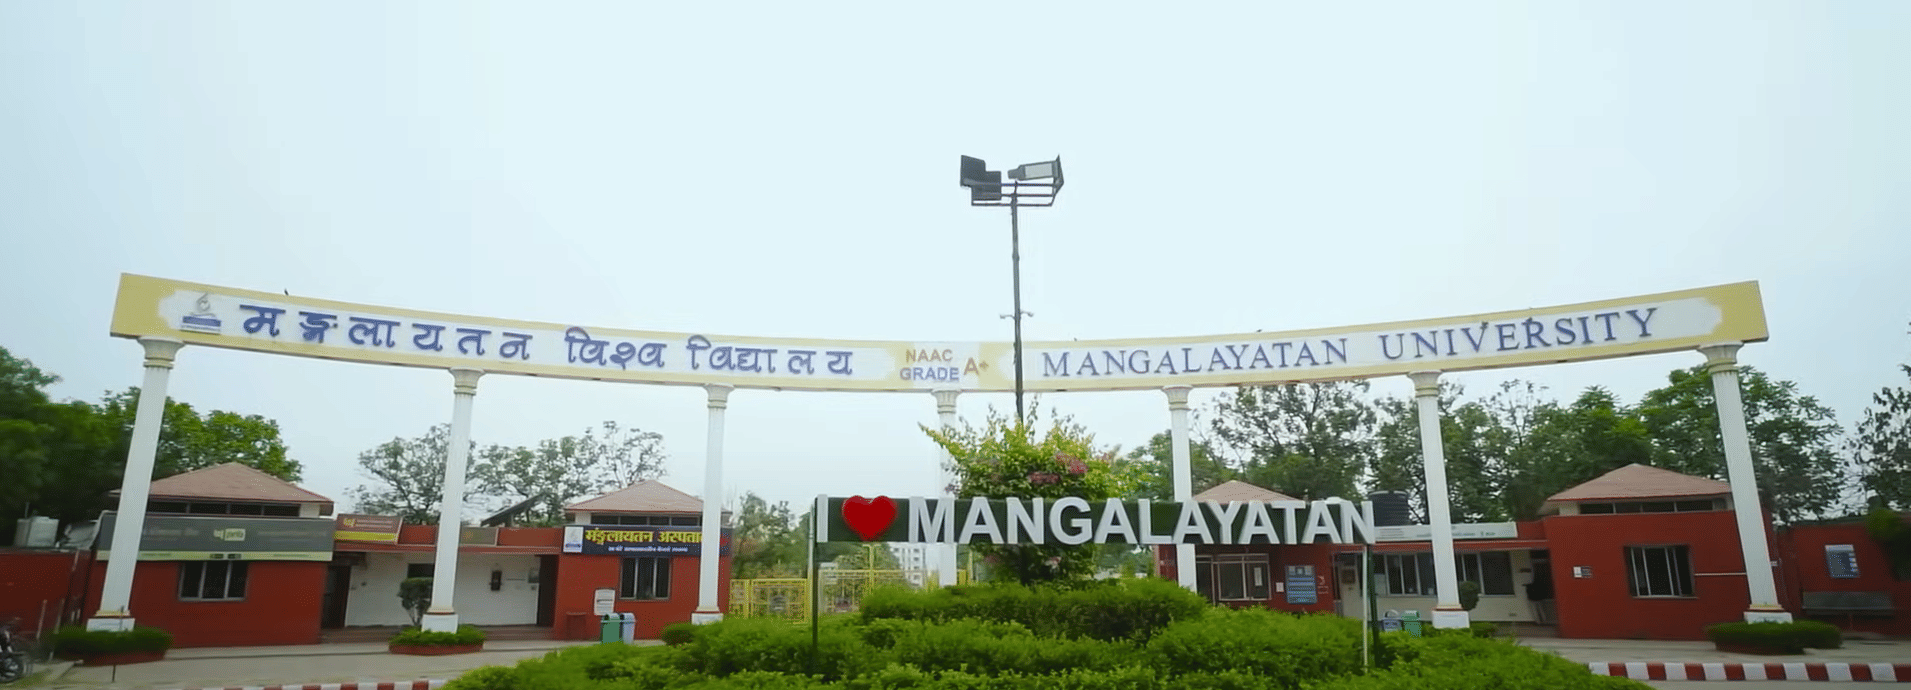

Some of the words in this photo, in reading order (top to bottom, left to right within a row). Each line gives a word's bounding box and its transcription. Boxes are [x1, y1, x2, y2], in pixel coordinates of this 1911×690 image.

[685, 334, 853, 376] विद्यालय
[905, 348, 953, 363] NAAC
[1041, 338, 1348, 377] MANGALAYATAN
[1378, 307, 1658, 361] UNIVERSITY
[899, 367, 960, 381] GRADE
[963, 357, 989, 376] A+
[816, 494, 829, 543] I
[908, 496, 1376, 545] MANGALAYATAN
[657, 531, 704, 543] अस्पता
